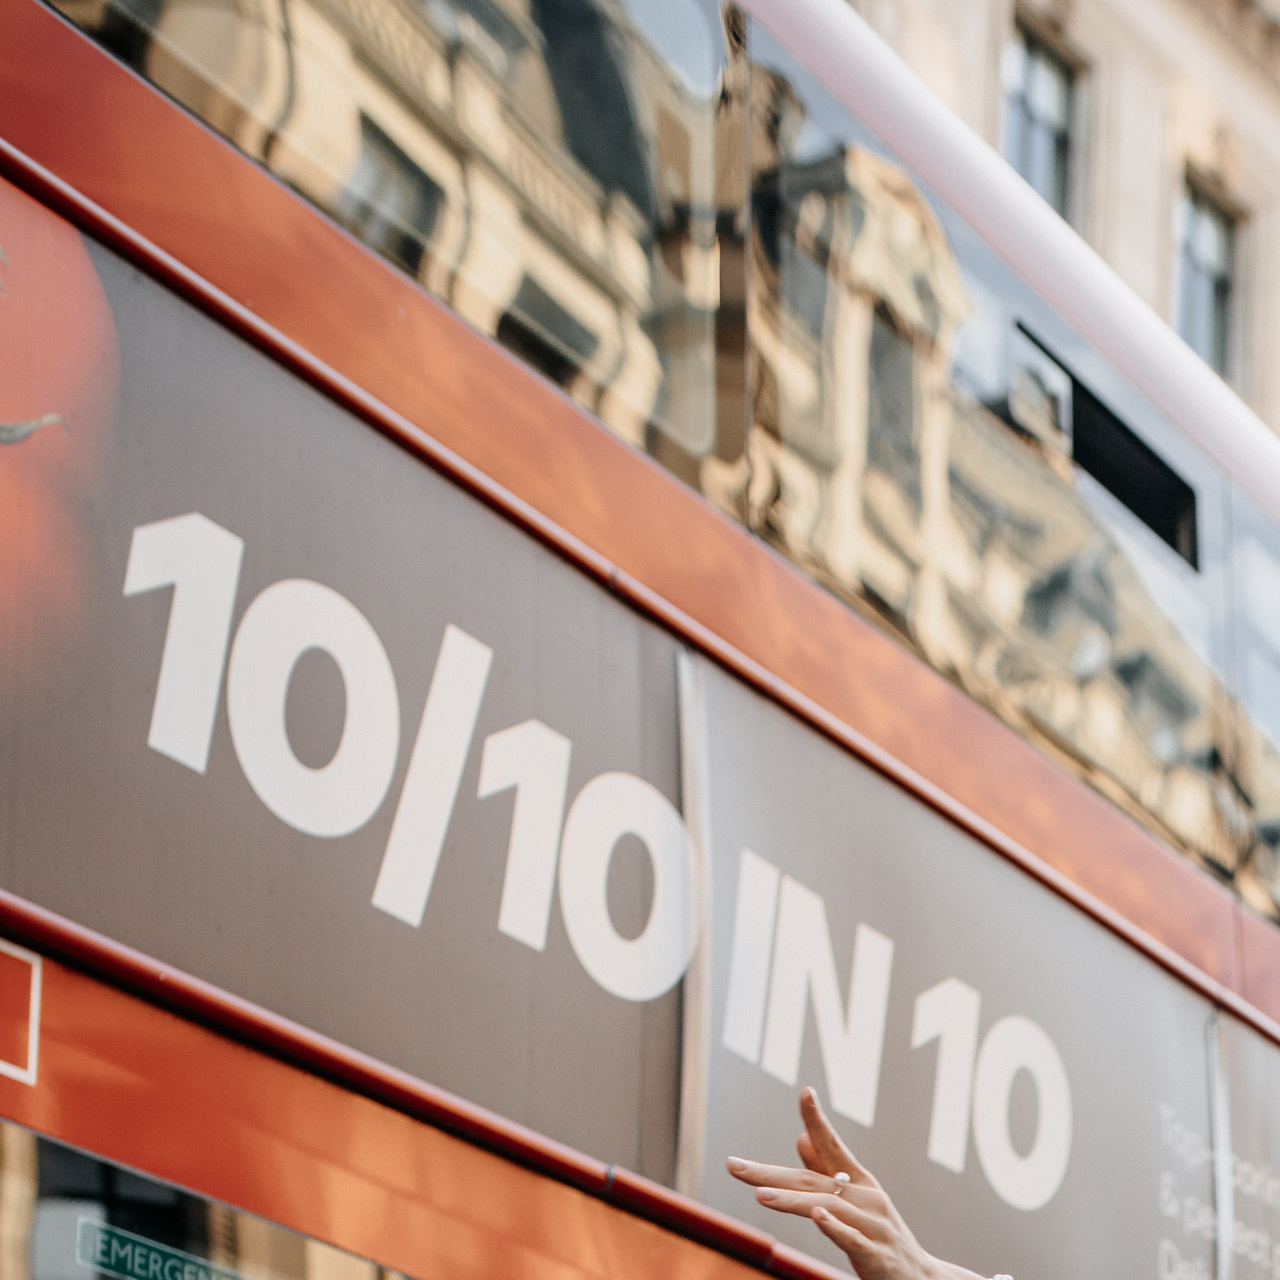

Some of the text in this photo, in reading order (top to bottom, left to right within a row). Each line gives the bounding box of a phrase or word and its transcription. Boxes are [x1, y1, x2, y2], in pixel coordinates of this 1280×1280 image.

[123, 511, 699, 1002] 10/10
[722, 848, 894, 1128] IN
[911, 976, 1073, 1211] 10
